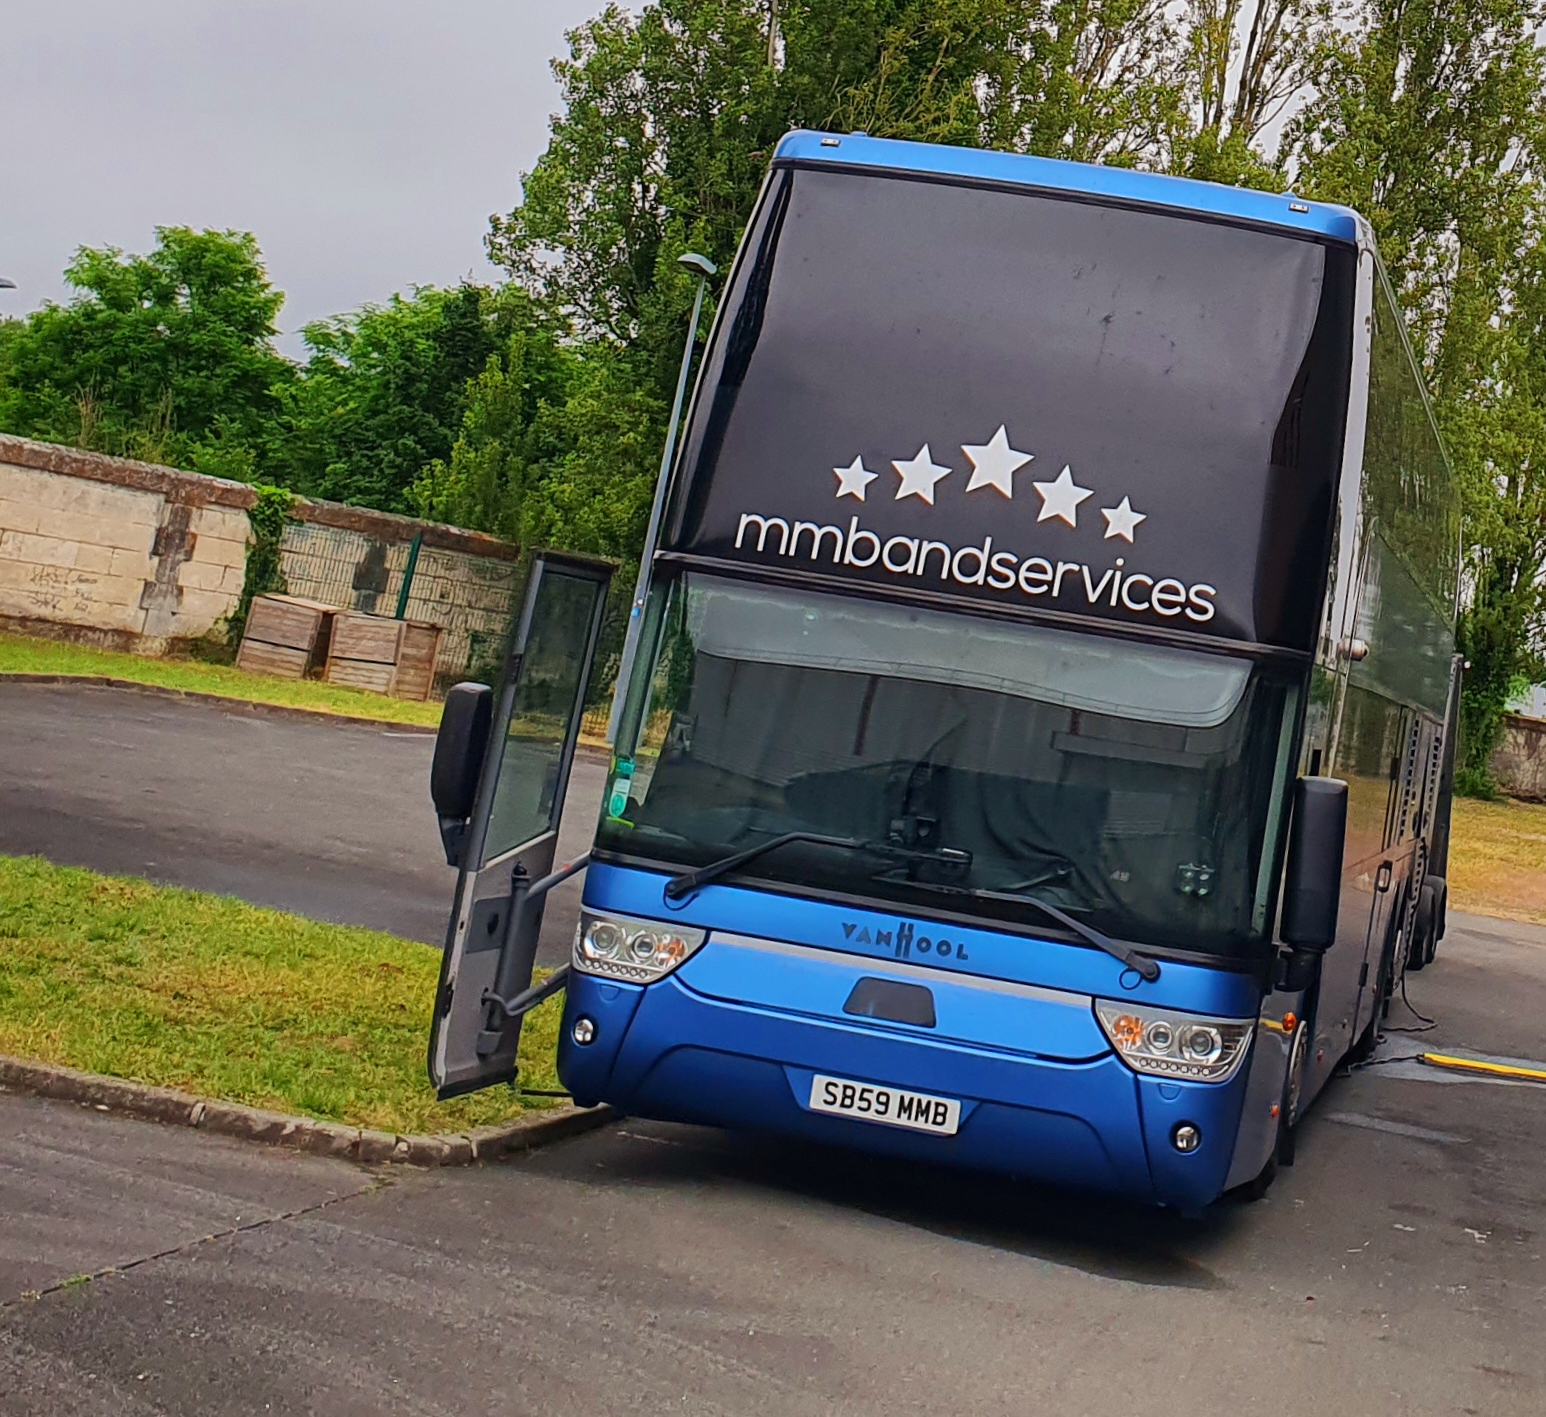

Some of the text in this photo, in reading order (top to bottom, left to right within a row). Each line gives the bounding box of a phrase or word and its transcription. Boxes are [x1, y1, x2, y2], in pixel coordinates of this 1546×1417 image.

[734, 511, 1217, 622] mmbandservices
[822, 1081, 949, 1127] SB59 MMB
